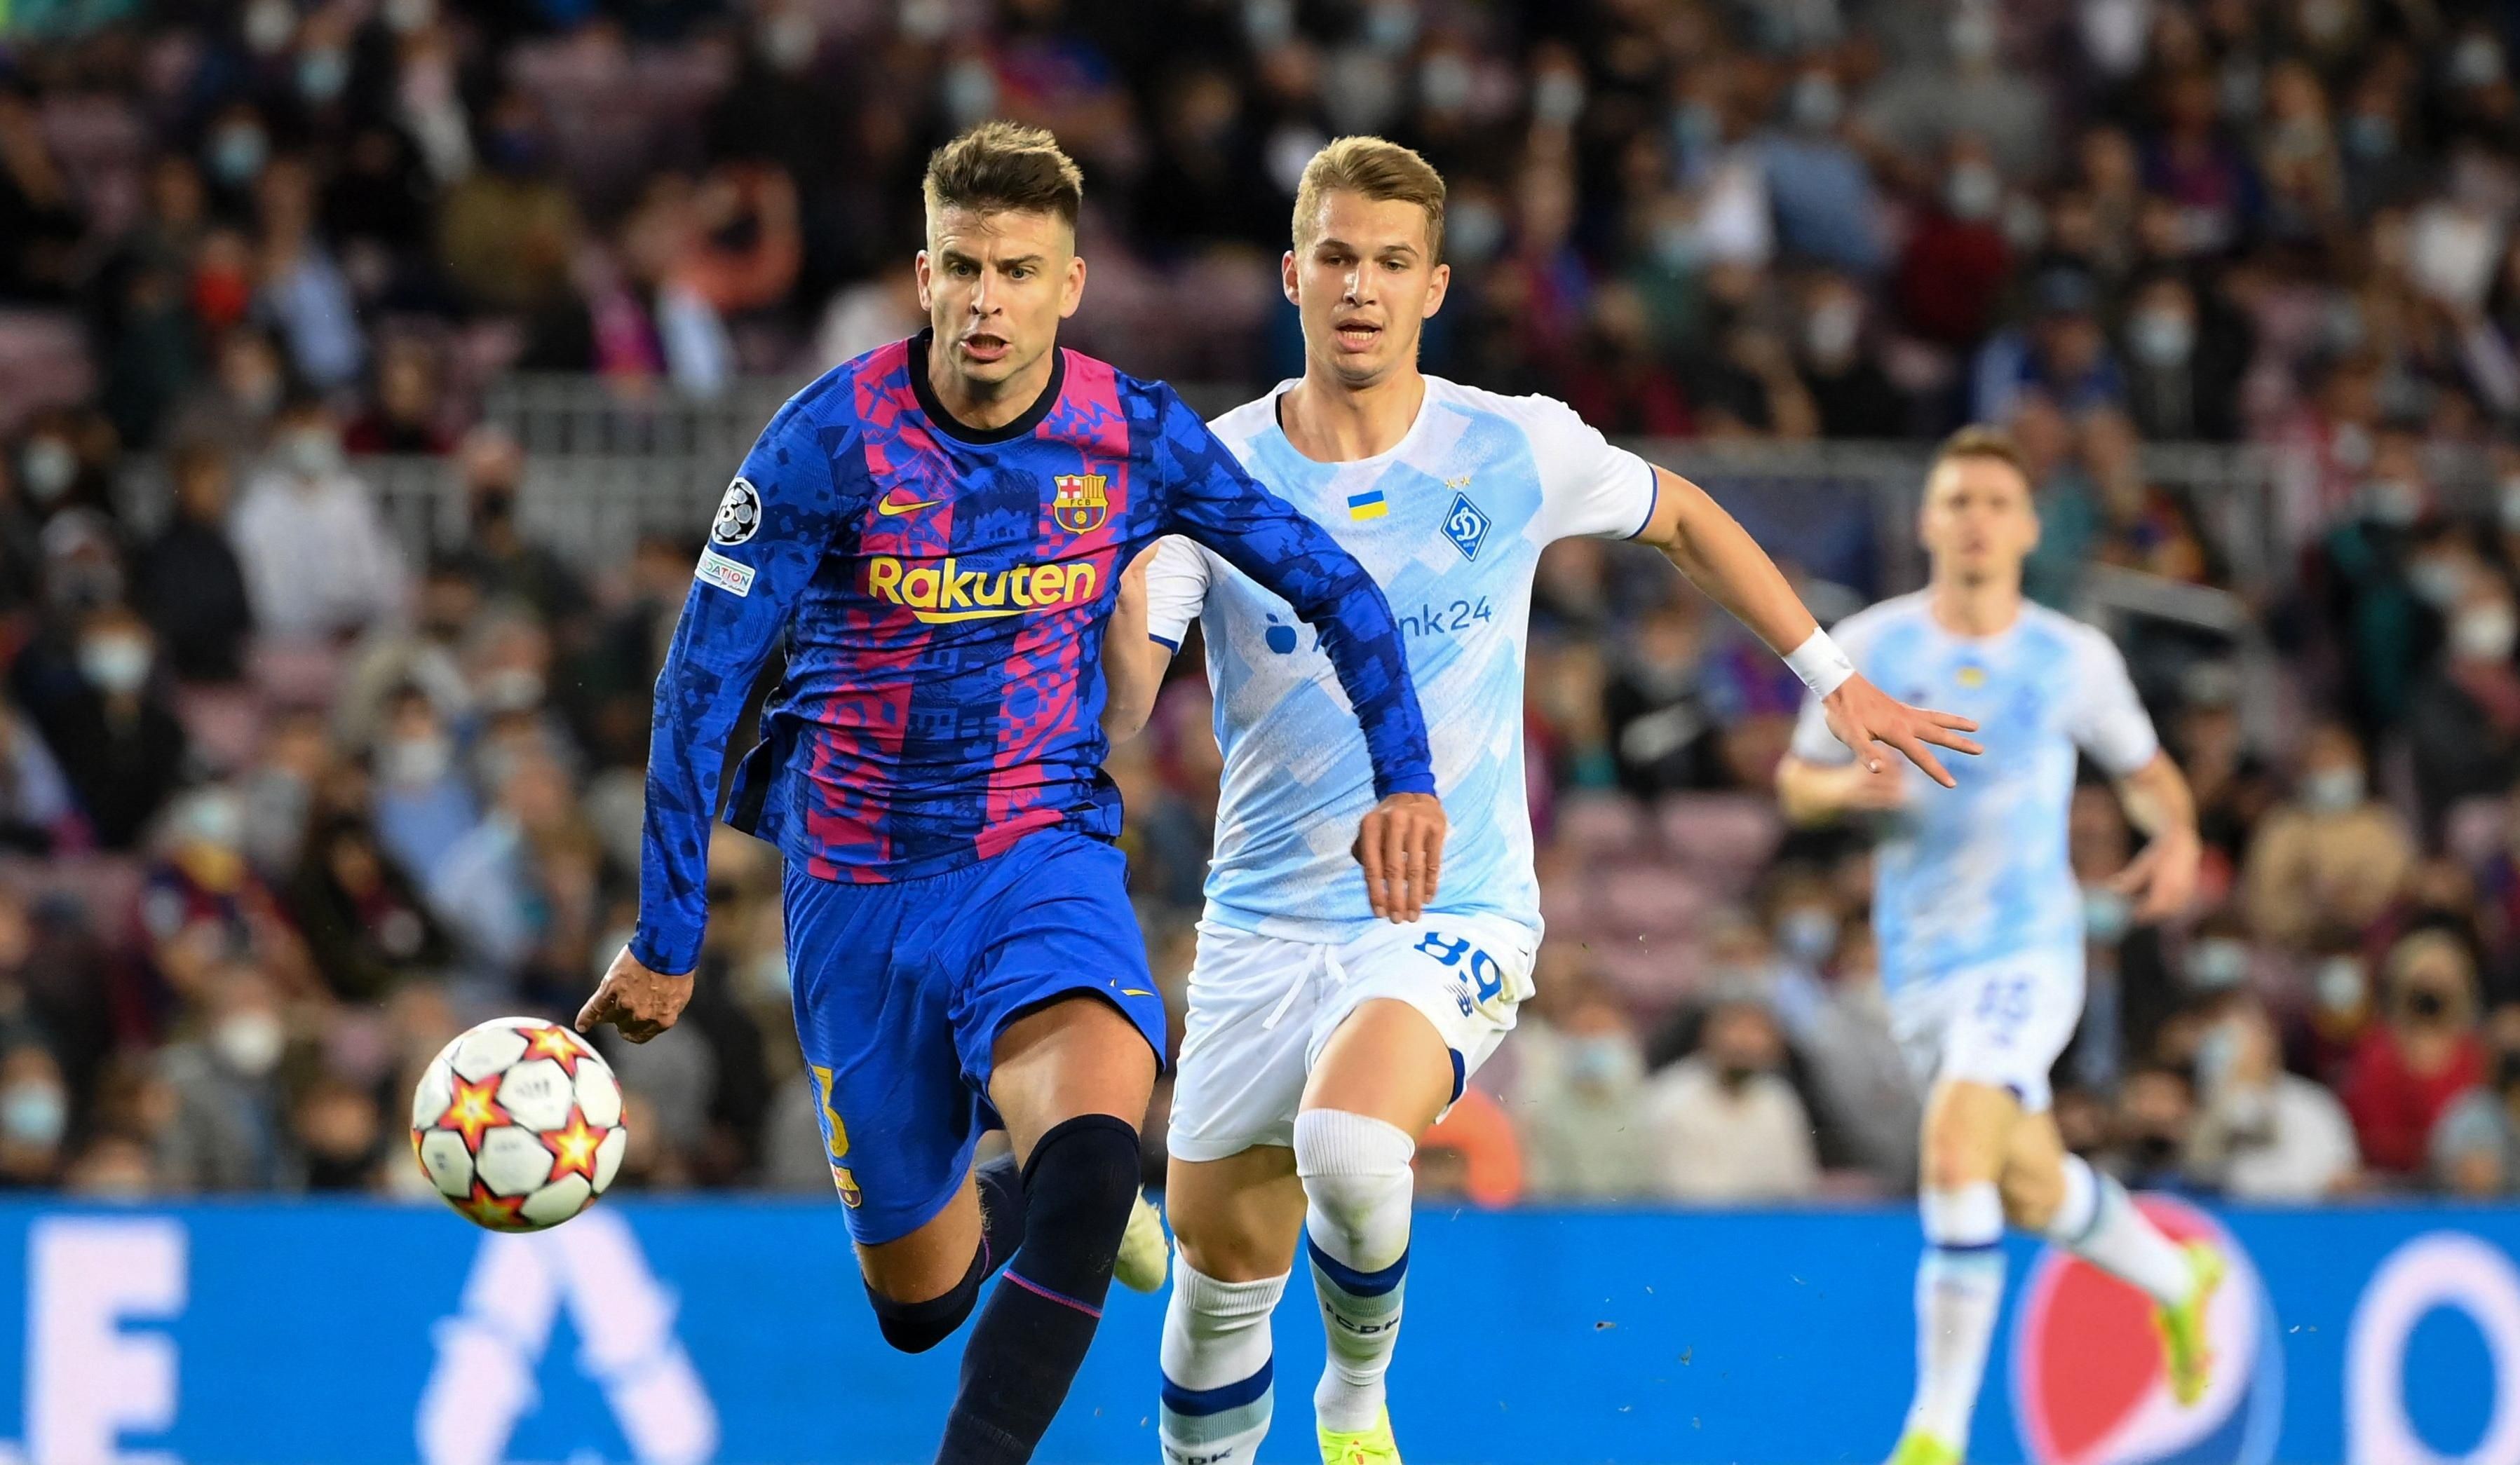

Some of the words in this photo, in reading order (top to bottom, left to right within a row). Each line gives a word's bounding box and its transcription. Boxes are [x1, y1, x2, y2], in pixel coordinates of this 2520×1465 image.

[703, 560, 750, 587] DATION
[869, 557, 1095, 608] Rakuten
[1399, 595, 1491, 636] nk24
[1414, 932, 1502, 1005] 89
[812, 1065, 849, 1157] 3
[0, 1216, 191, 1465] E
